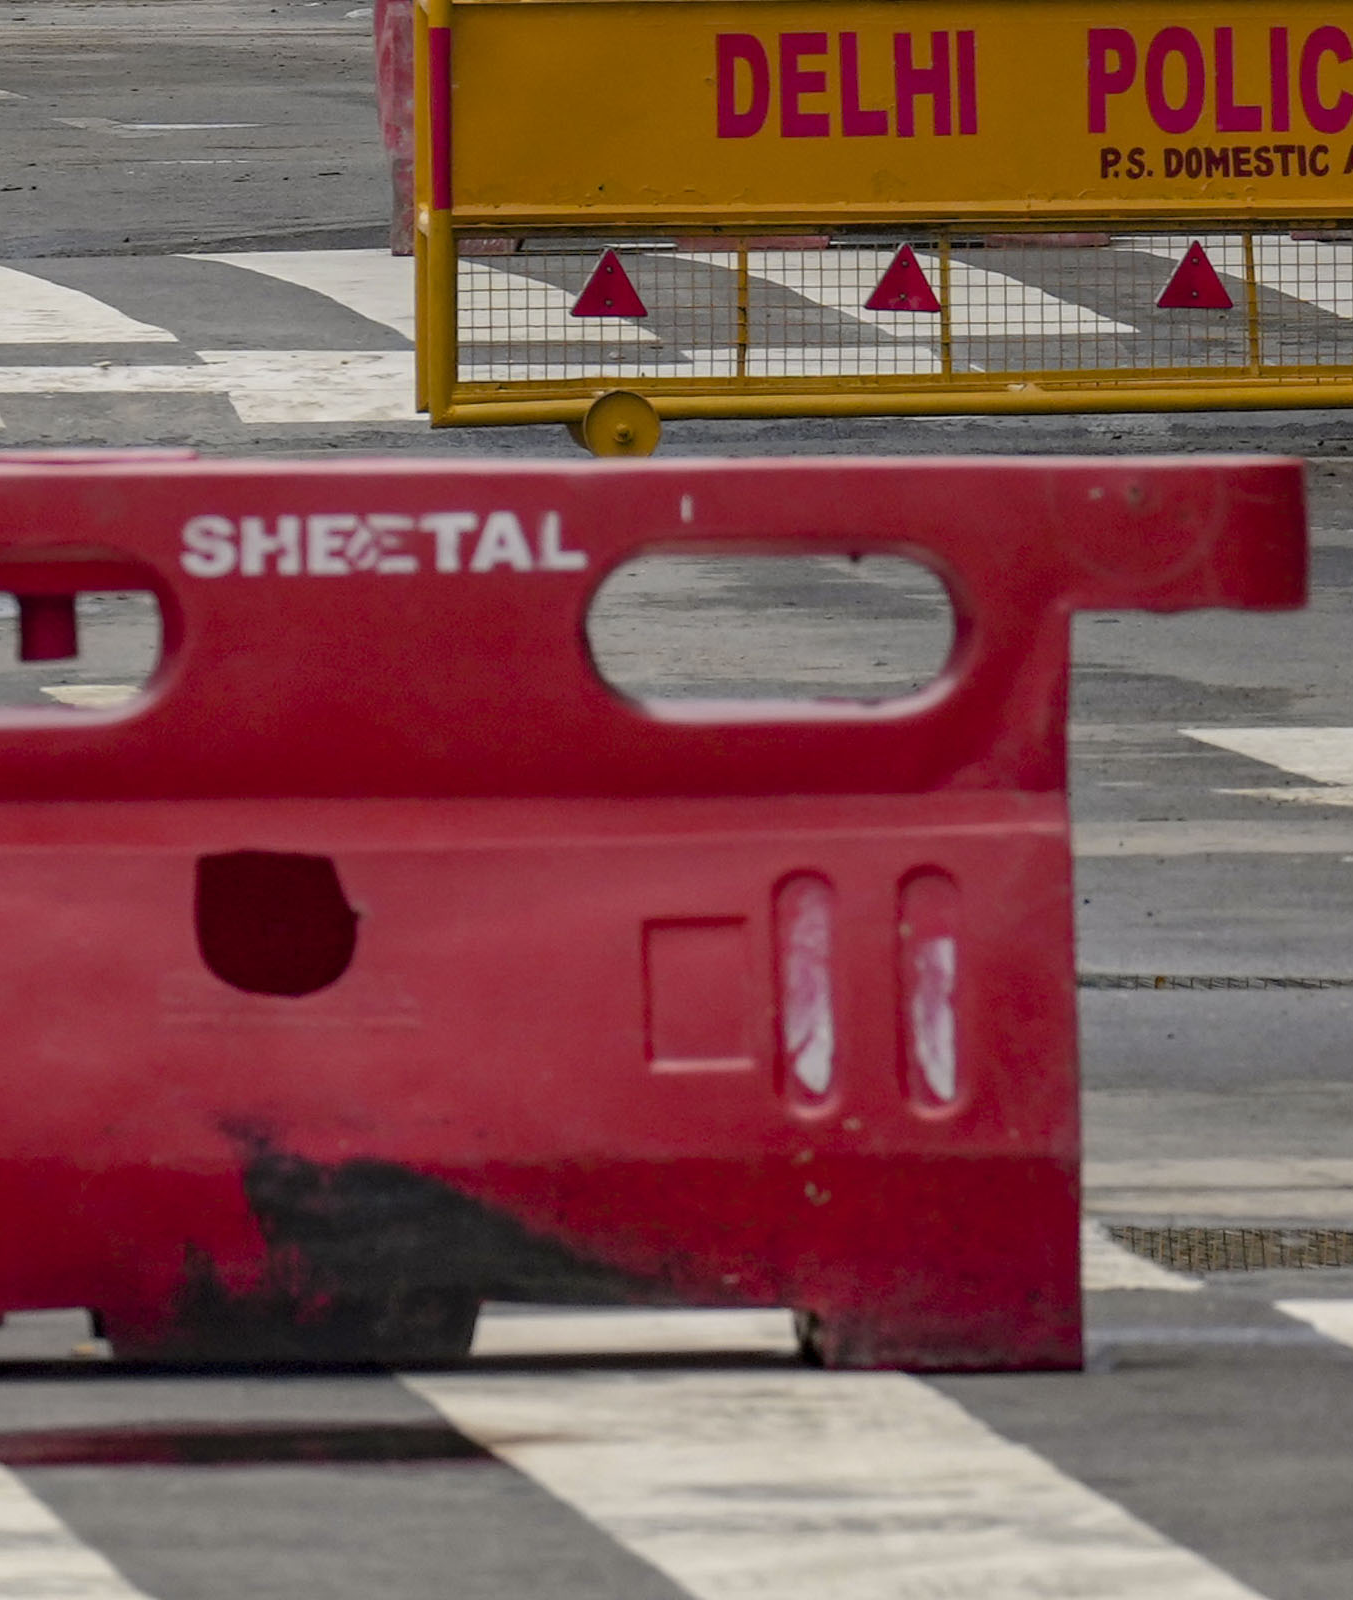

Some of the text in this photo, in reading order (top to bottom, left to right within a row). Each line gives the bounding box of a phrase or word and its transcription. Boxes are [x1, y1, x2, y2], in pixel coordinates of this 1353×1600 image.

[716, 30, 978, 138] DELHI
[1100, 147, 1153, 179] P.S.
[1164, 145, 1330, 178] DOMESTIC
[179, 510, 589, 578] SHEETAL
